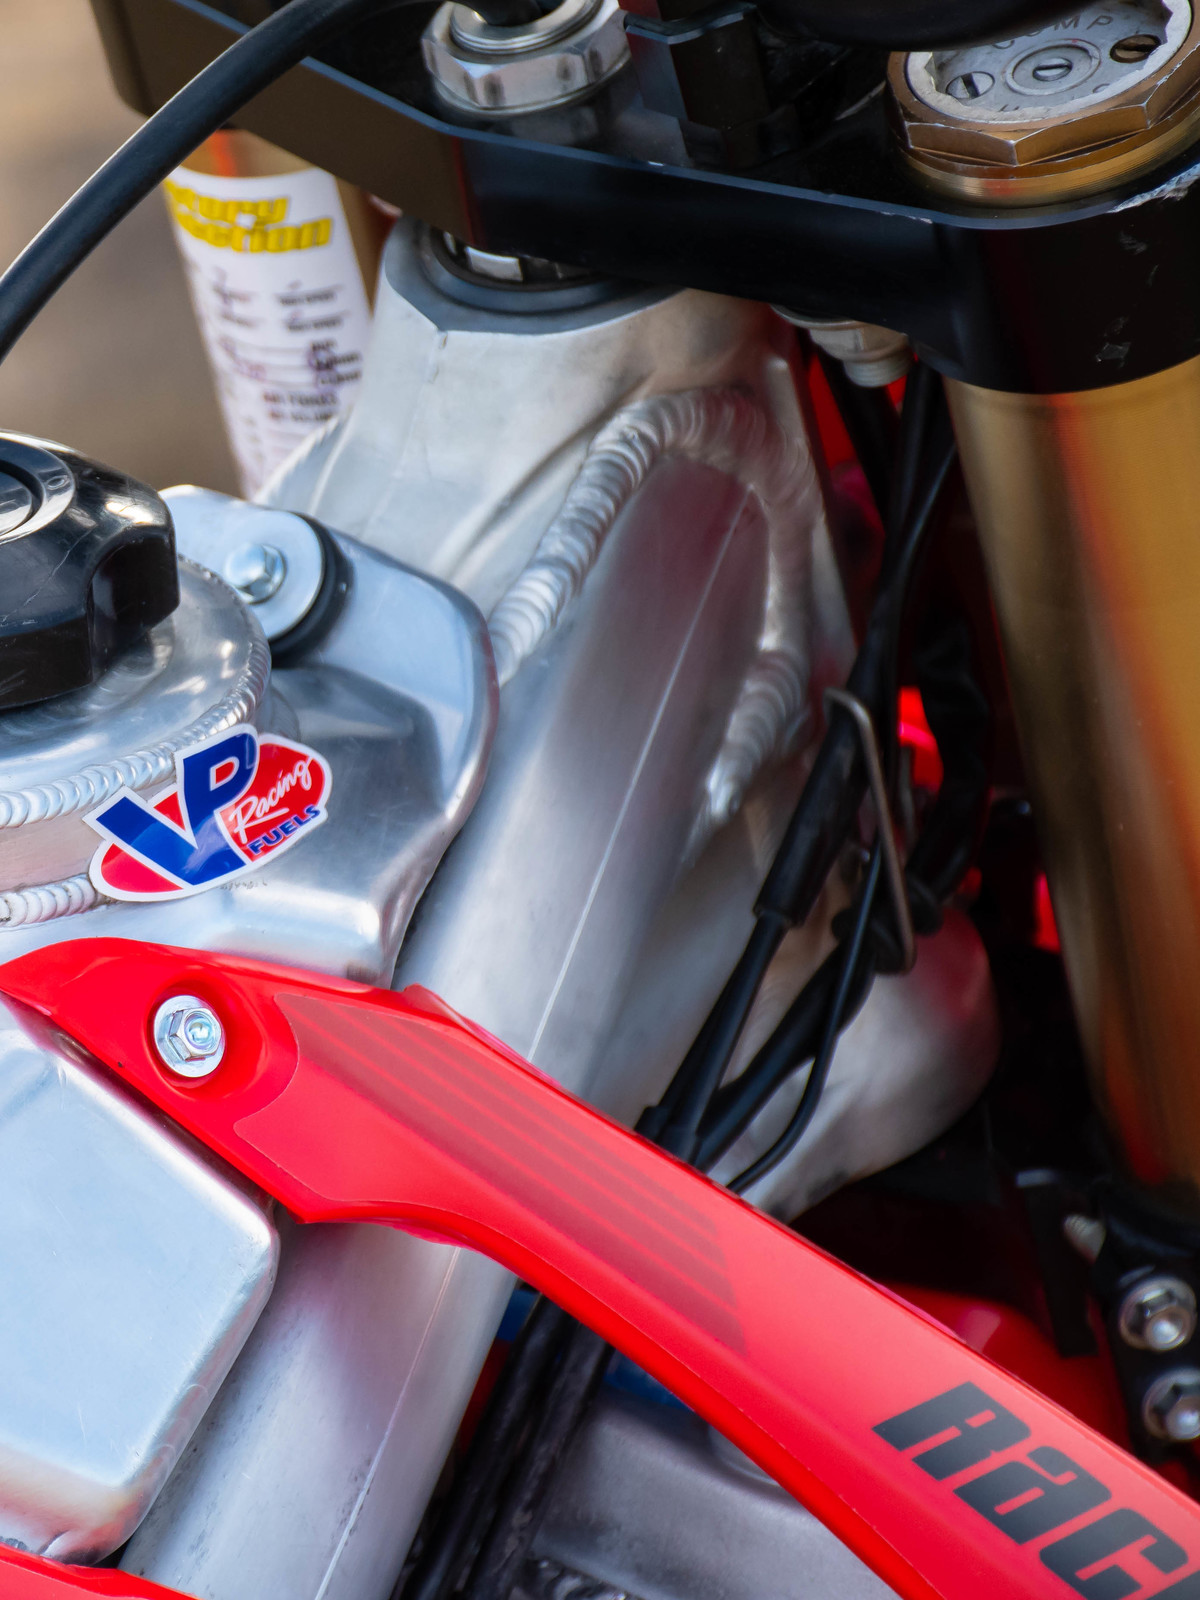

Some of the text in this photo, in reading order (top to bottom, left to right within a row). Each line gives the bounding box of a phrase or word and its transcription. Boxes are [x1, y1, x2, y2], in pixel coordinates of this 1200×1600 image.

[95, 732, 259, 886] VP
[228, 756, 314, 845] Racing
[247, 804, 321, 856] FUELS
